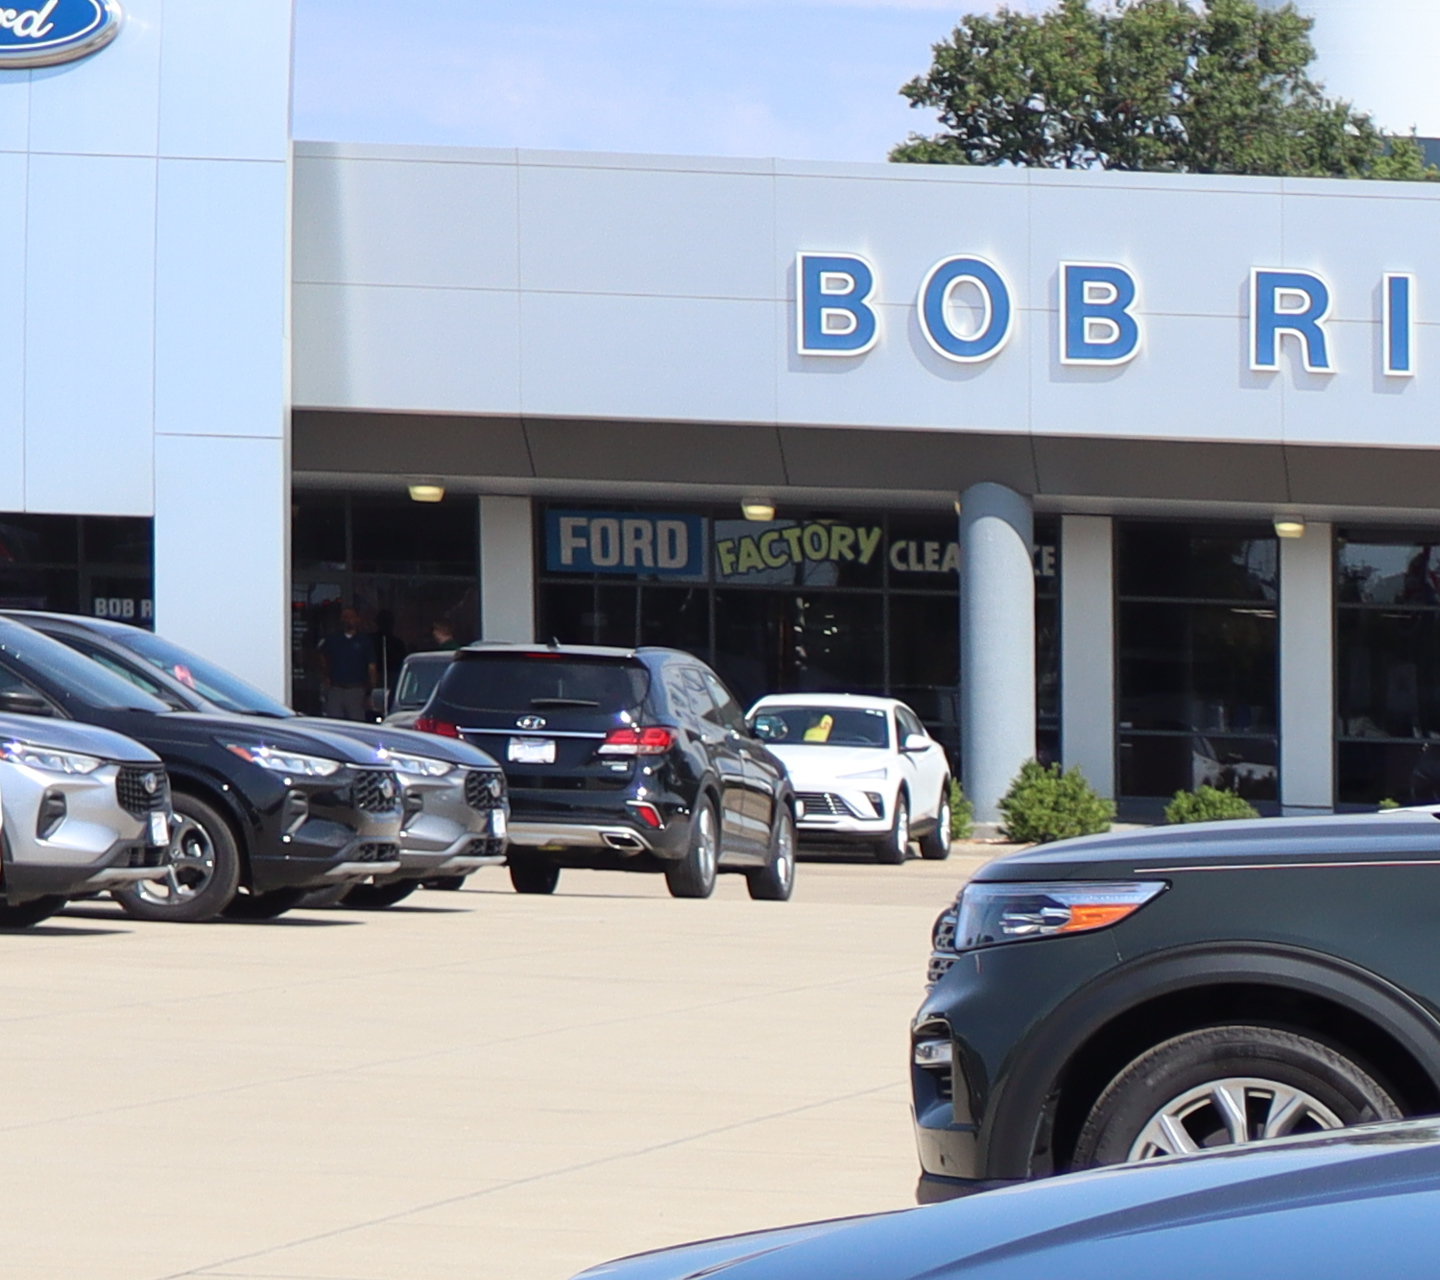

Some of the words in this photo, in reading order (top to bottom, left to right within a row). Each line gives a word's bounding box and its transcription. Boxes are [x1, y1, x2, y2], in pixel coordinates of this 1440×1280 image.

[797, 253, 1143, 366] BOB
[559, 516, 689, 569] FORD
[716, 524, 882, 575] FACTORY
[889, 540, 1055, 576] CLEAE
[95, 598, 134, 617] BOB
